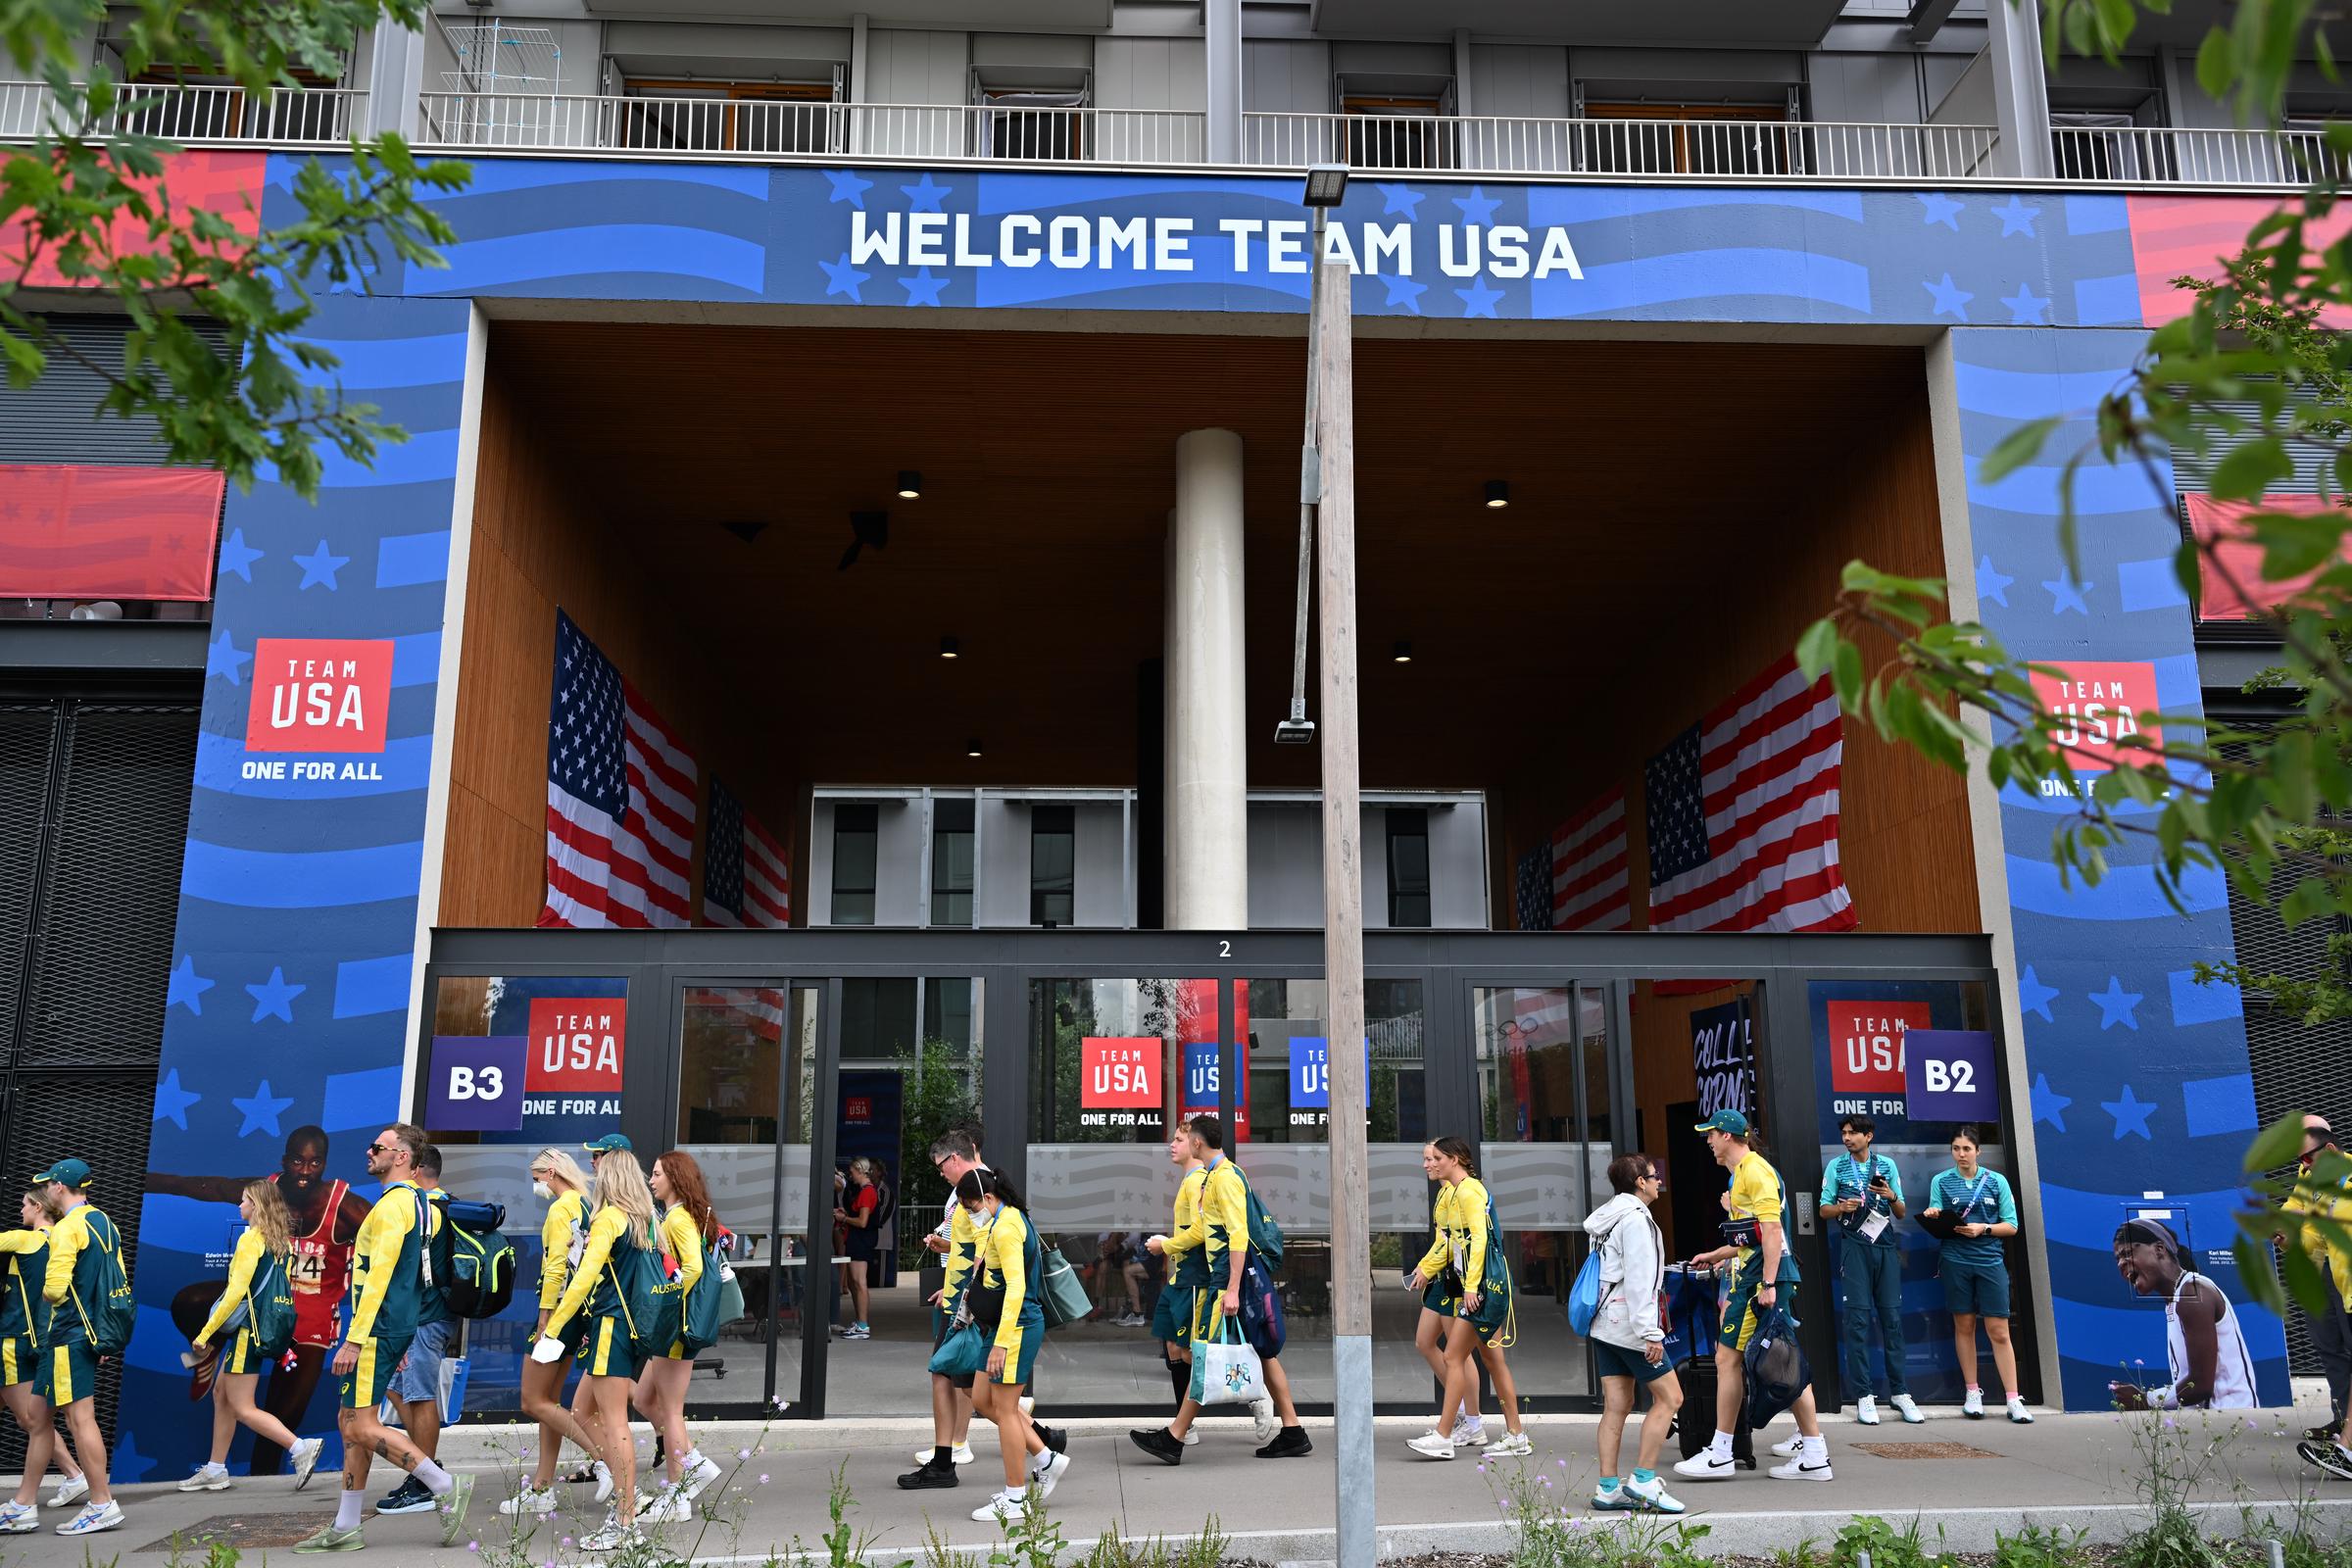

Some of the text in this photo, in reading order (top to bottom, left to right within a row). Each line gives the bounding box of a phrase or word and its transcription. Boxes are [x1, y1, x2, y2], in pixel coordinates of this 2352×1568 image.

[850, 211, 1585, 280] WELCOME TEAM USA
[288, 660, 357, 678] TEAM
[2060, 681, 2124, 699] TEAM
[270, 682, 365, 732] USA
[2053, 703, 2143, 750] USA
[241, 761, 383, 781] ONE FOR ALL
[1219, 940, 1231, 958] 2
[556, 1014, 611, 1031] TEAM
[1853, 1017, 1905, 1033] TEAM
[543, 1033, 618, 1074] USA
[1101, 1050, 1142, 1062] TEAM
[1197, 1054, 1219, 1065] TEA
[1307, 1050, 1325, 1061] TE
[448, 1065, 504, 1101] B3
[1094, 1063, 1149, 1096] USA
[1192, 1066, 1220, 1095] US
[1301, 1064, 1329, 1094] US
[1925, 1059, 1977, 1093] B2
[522, 1100, 621, 1115] ONE FOR AL
[850, 1105, 866, 1115] USA
[1834, 1100, 1904, 1115] ONE FOR
[1081, 1113, 1162, 1126] ONE FOR ALL
[1290, 1113, 1315, 1125] ONE
[1664, 1335, 1680, 1346] ALL
